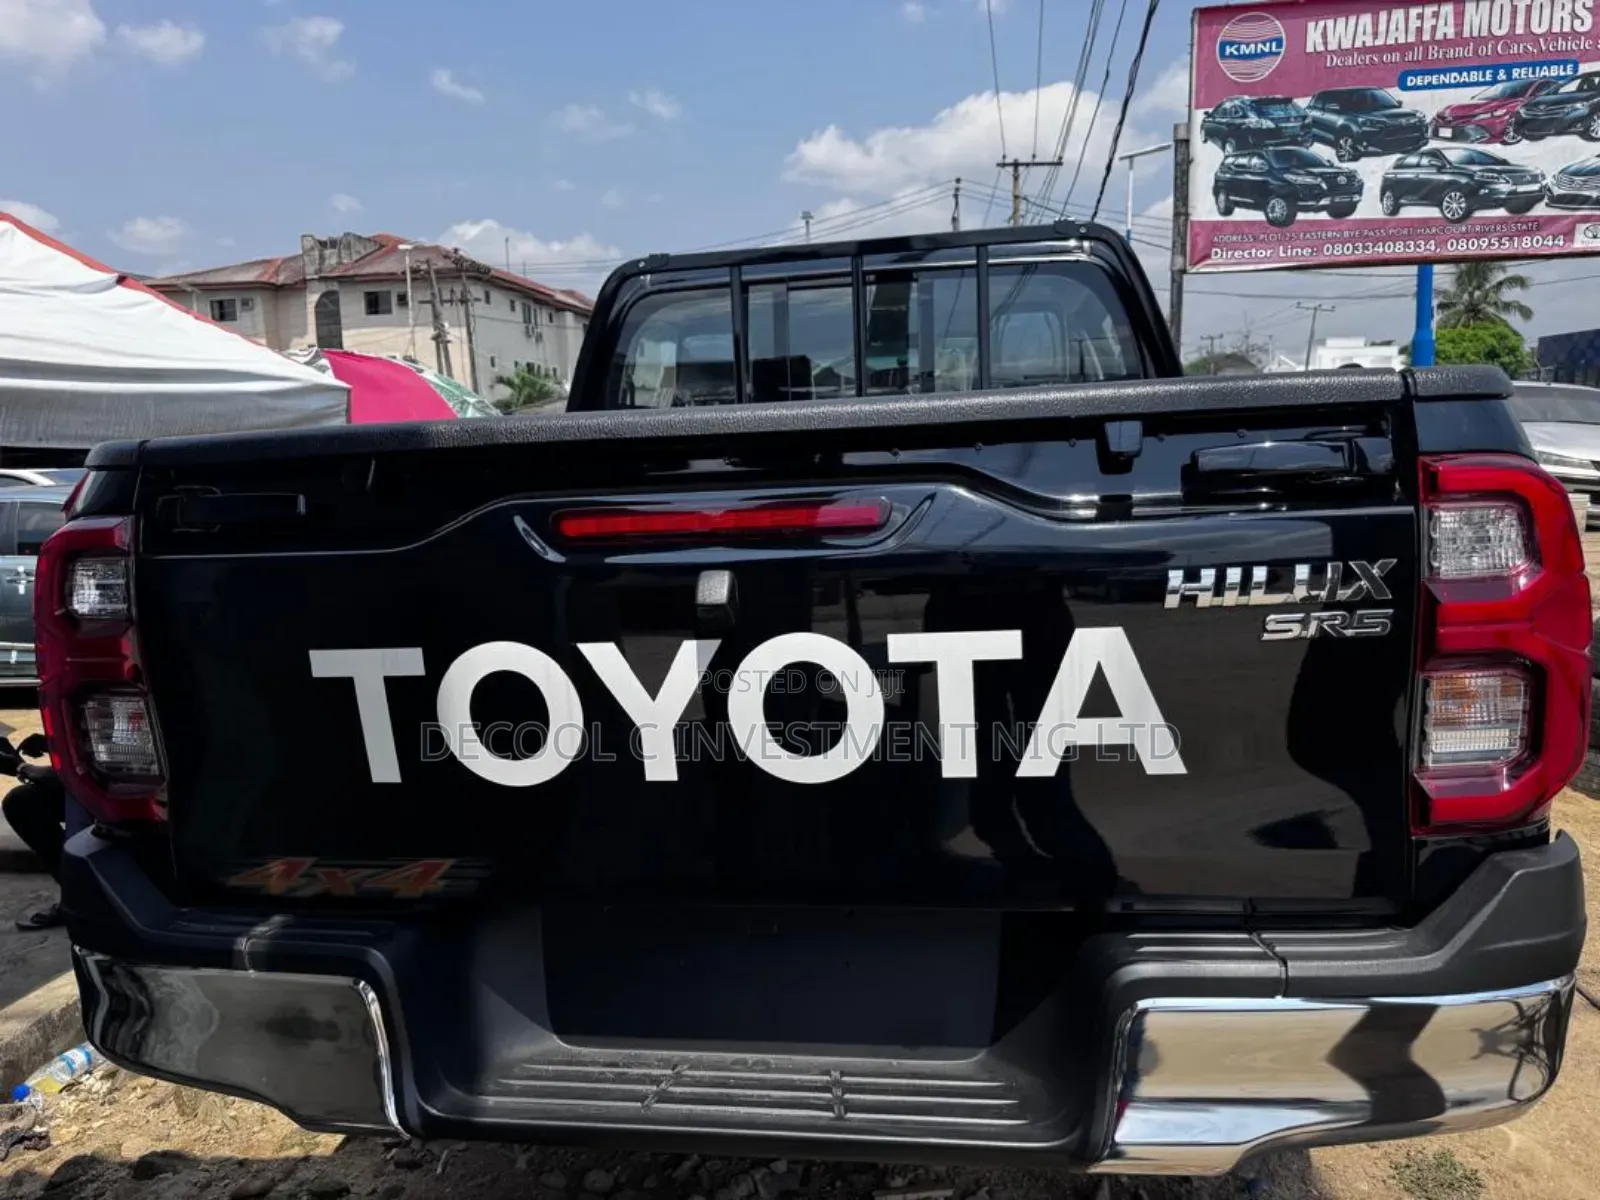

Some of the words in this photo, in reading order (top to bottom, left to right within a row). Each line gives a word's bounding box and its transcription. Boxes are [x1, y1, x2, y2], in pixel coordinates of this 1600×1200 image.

[1305, 3, 1455, 53] KWAJAFFA
[1462, 0, 1593, 38] MOTORS
[1224, 41, 1283, 56] KMNL
[1326, 52, 1379, 68] Dealers
[1383, 53, 1400, 64] on
[1404, 46, 1422, 62] all
[1428, 43, 1473, 61] Brand
[1478, 41, 1495, 56] of
[1497, 39, 1537, 55] Cars,
[1539, 36, 1592, 52] Vehicle
[1406, 69, 1494, 87] DEPENDABLE
[1497, 69, 1507, 81] &
[1512, 64, 1574, 80] RELIABLE
[1299, 230, 1340, 240] EASTERN
[1343, 229, 1361, 238] BYE
[1363, 228, 1386, 237] PASS
[1389, 227, 1413, 236] PORT
[1416, 225, 1471, 235] HARCOURT
[1475, 224, 1509, 233] RIVERS
[1511, 222, 1539, 231] STATE
[1211, 247, 1273, 260] Director
[1279, 245, 1317, 258] Line:
[1323, 239, 1441, 256] 08033408334,
[1447, 235, 1565, 251] 08095518044
[1164, 558, 1398, 609] HILUX
[1260, 609, 1395, 641] SR5
[309, 627, 1188, 788] TOYOTA
[226, 857, 457, 898] 4x4
